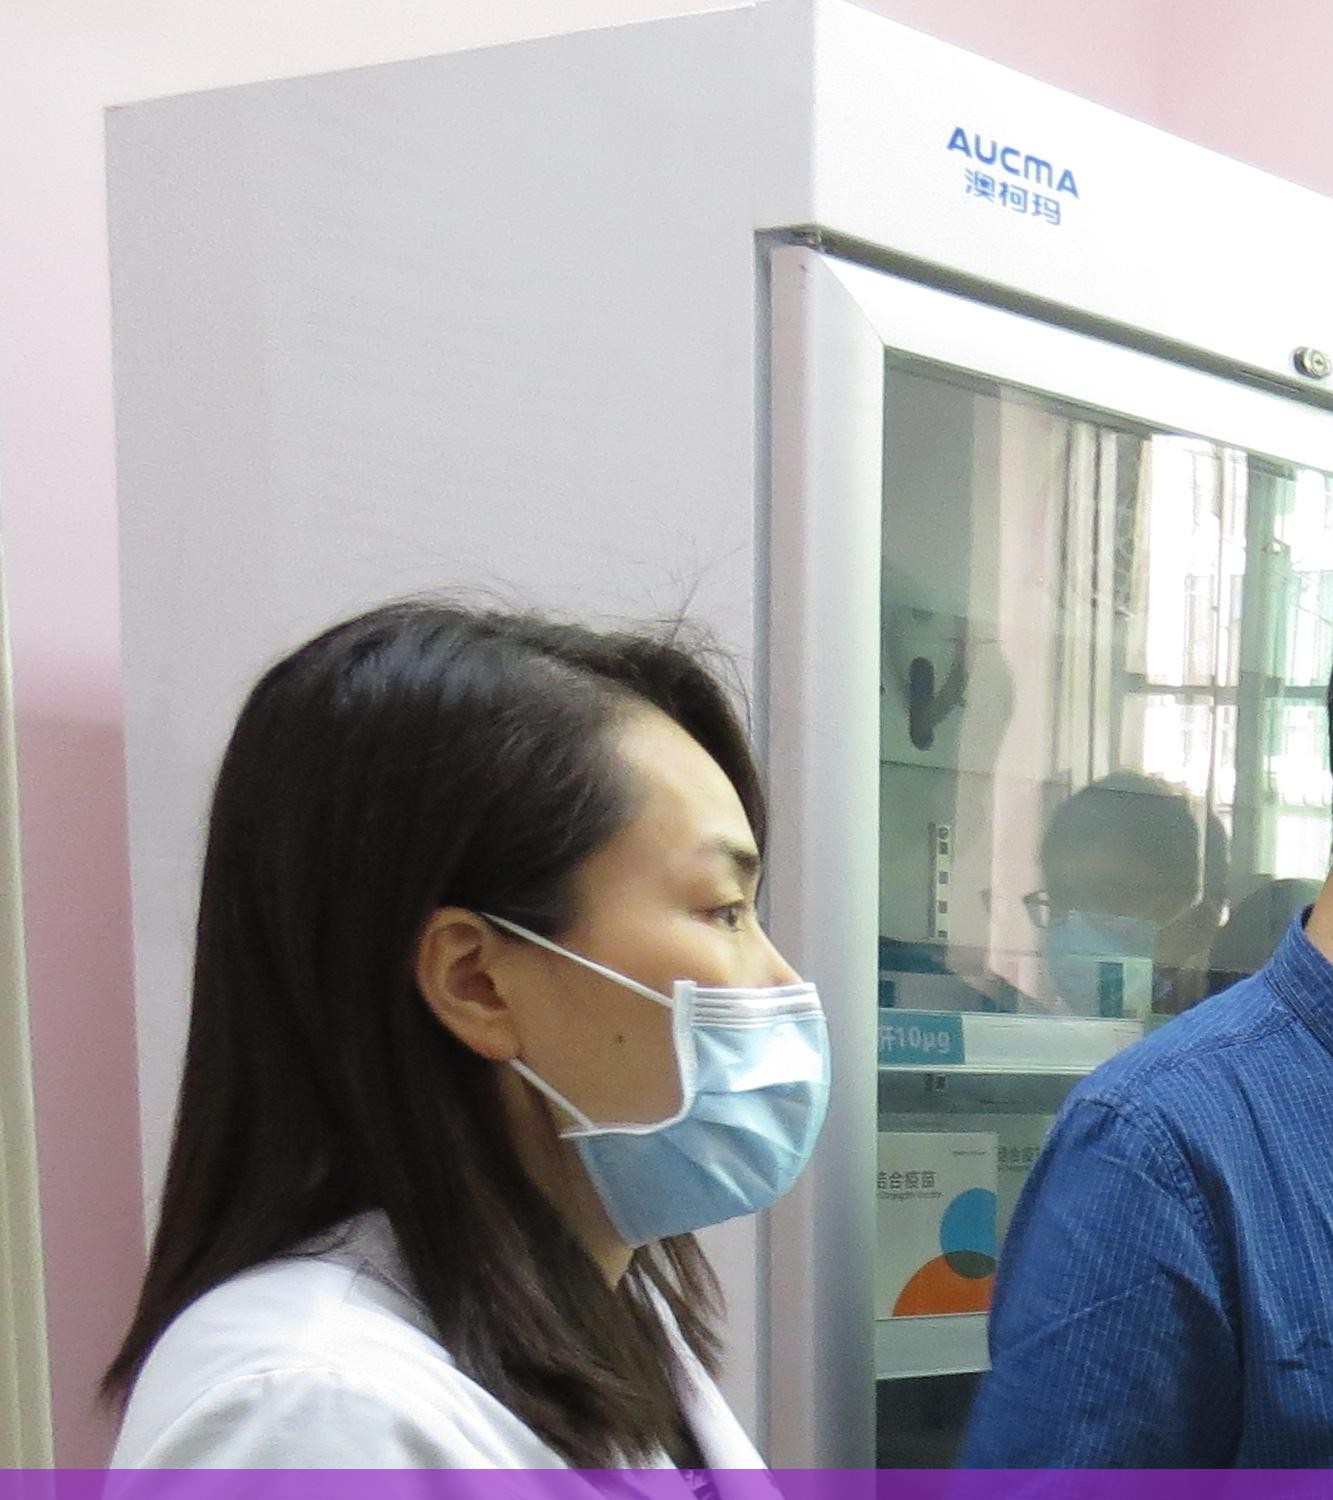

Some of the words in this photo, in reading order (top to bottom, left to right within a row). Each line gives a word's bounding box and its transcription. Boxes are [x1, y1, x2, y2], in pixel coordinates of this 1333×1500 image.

[947, 126, 1079, 200] AUCMA
[964, 167, 1061, 226] 澳柯玛
